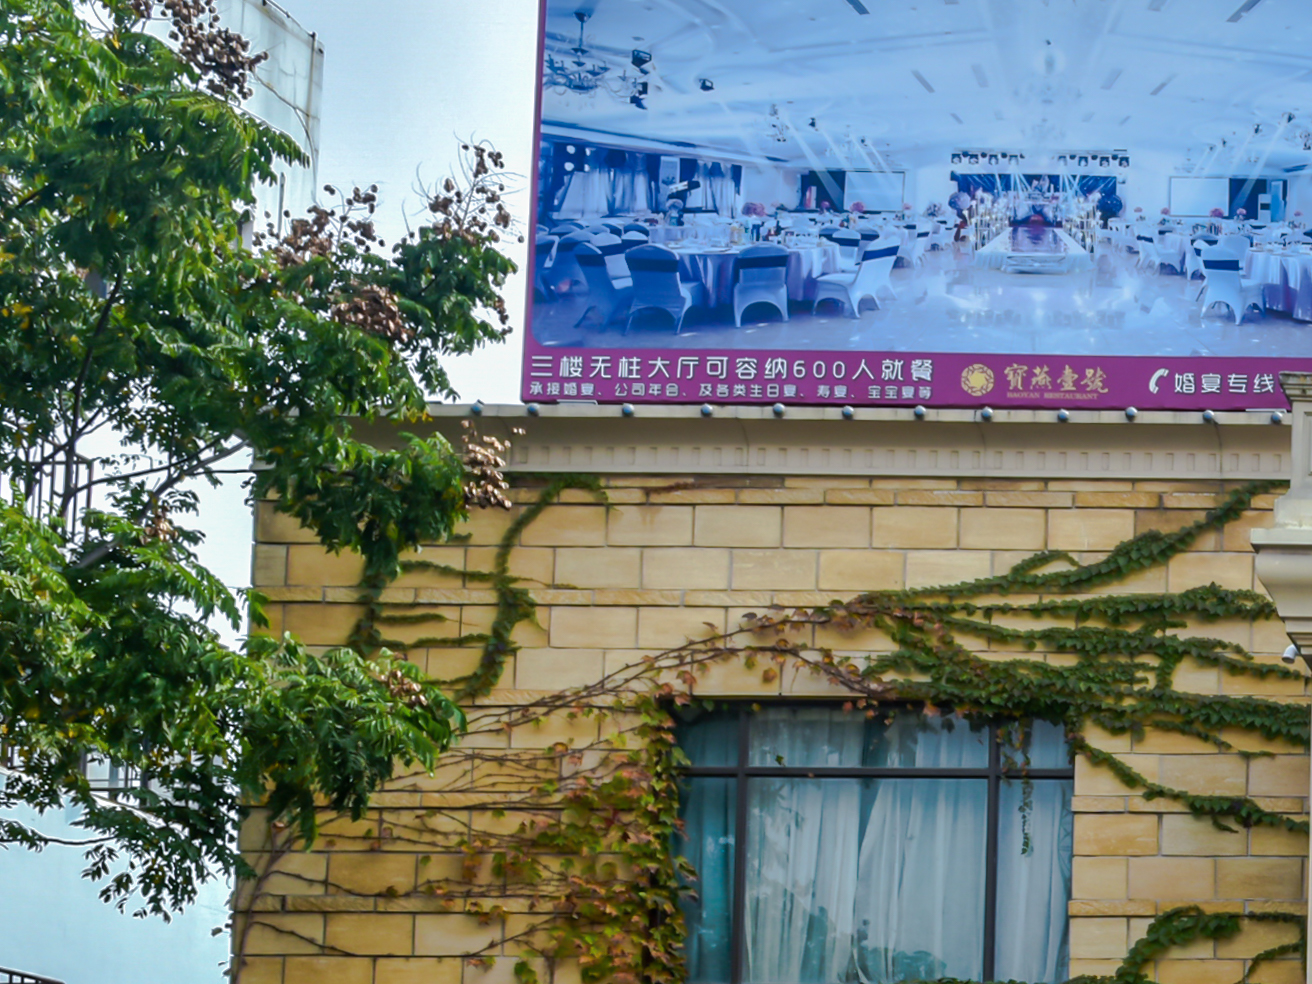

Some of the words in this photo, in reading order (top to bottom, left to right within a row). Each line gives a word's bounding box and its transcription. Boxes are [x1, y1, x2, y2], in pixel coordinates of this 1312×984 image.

[530, 355, 933, 381] 三楼无柱大厅可容纳600人就餐
